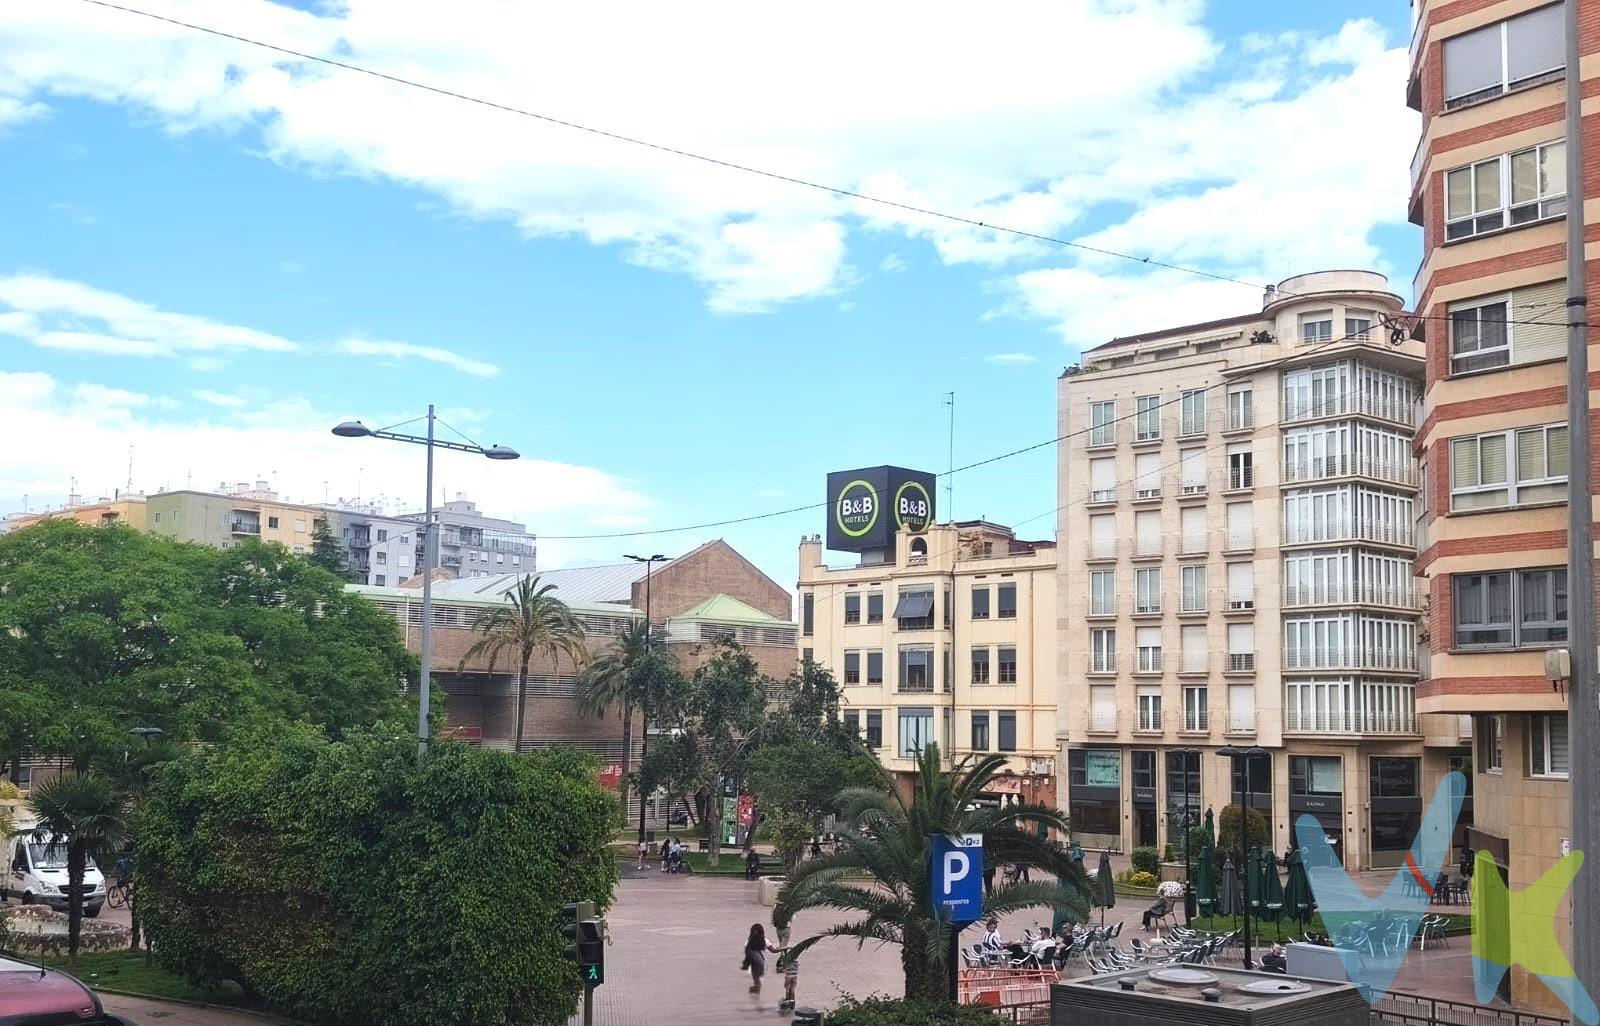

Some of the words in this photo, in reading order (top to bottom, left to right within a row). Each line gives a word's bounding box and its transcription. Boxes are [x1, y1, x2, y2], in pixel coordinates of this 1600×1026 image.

[842, 496, 873, 516] B&B
[900, 497, 927, 517] B&B
[844, 515, 870, 524] HOTELS
[902, 515, 924, 525] HOTELS
[943, 851, 970, 895] P
